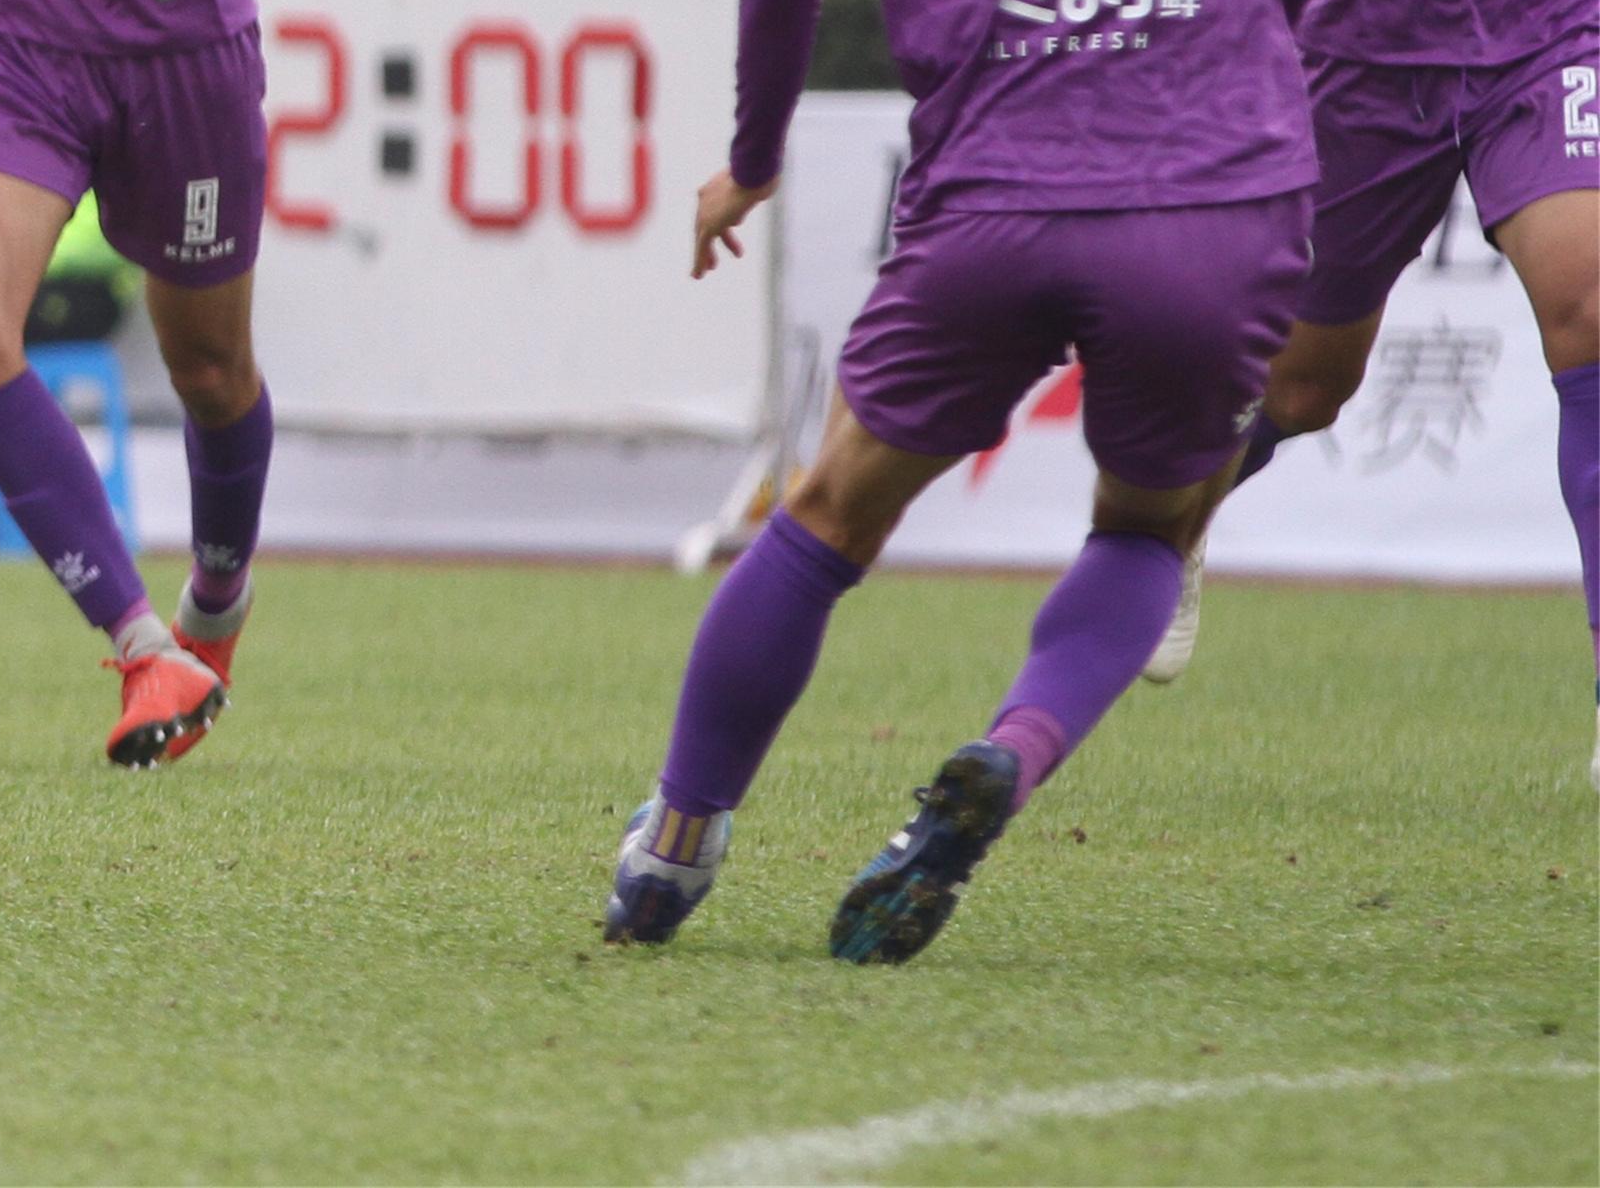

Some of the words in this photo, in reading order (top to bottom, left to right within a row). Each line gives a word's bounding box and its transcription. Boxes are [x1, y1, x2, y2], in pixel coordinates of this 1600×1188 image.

[1044, 30, 1151, 56] FRESH
[1562, 65, 1599, 139] 2
[1564, 139, 1600, 159] KE
[184, 176, 220, 246] 9
[163, 236, 236, 262] KELME
